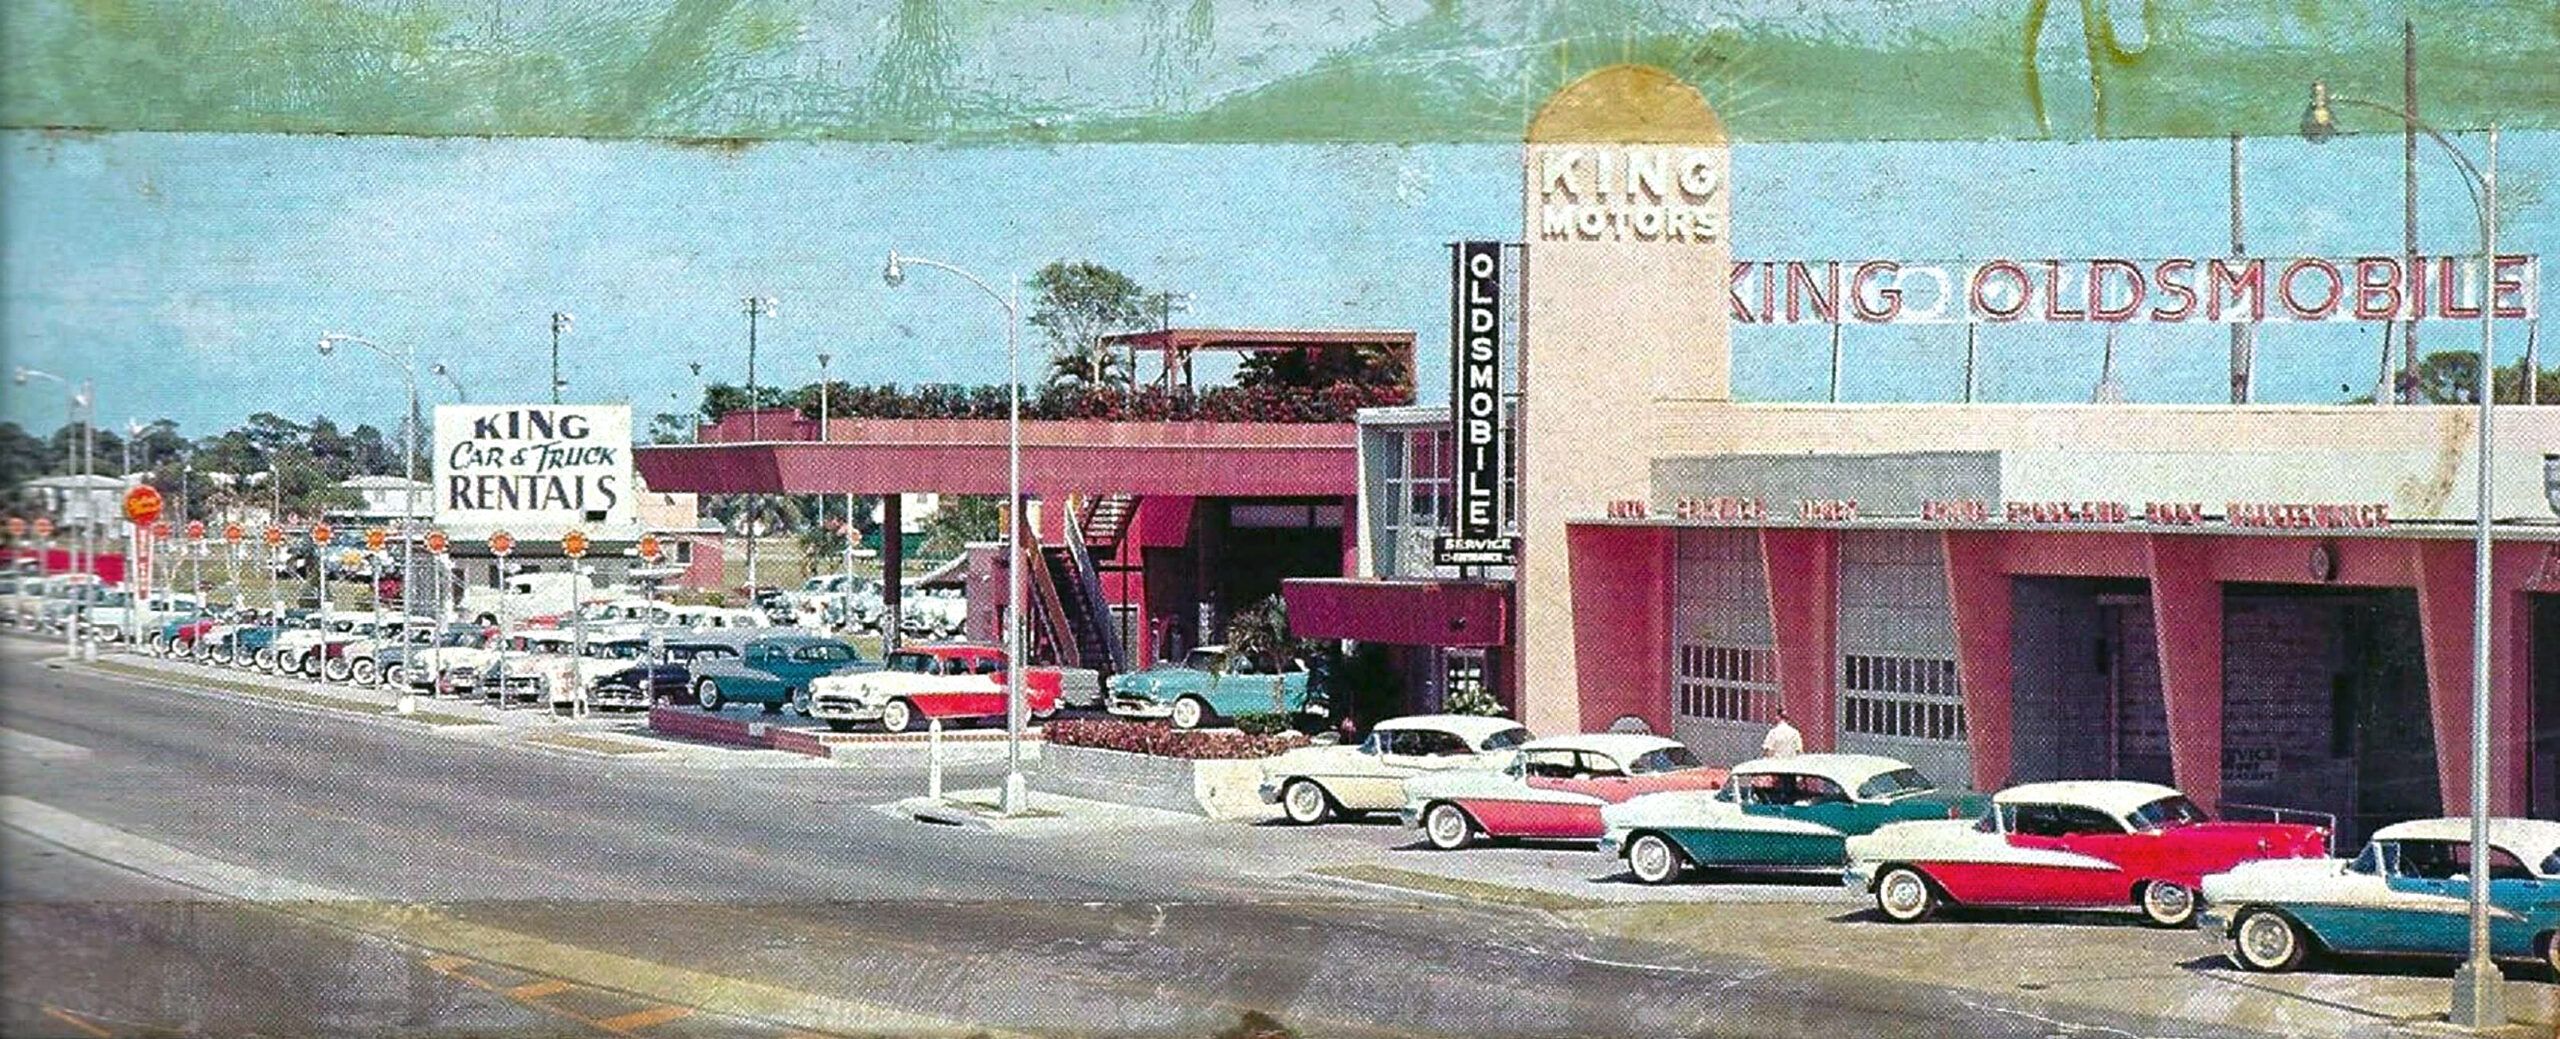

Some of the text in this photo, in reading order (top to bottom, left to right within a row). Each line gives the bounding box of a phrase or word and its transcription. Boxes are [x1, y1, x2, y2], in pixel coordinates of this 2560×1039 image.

[1542, 149, 1720, 203] KING
[1542, 204, 1719, 241] MOTORS
[1730, 256, 2527, 323] KING OLDSMOBILE
[1470, 253, 1494, 525] OLDSMOBILE
[473, 409, 590, 440] KING
[450, 440, 617, 474] CAR & TRUCK
[449, 474, 617, 511] RENTALS
[1445, 539, 1512, 550] SERVICE
